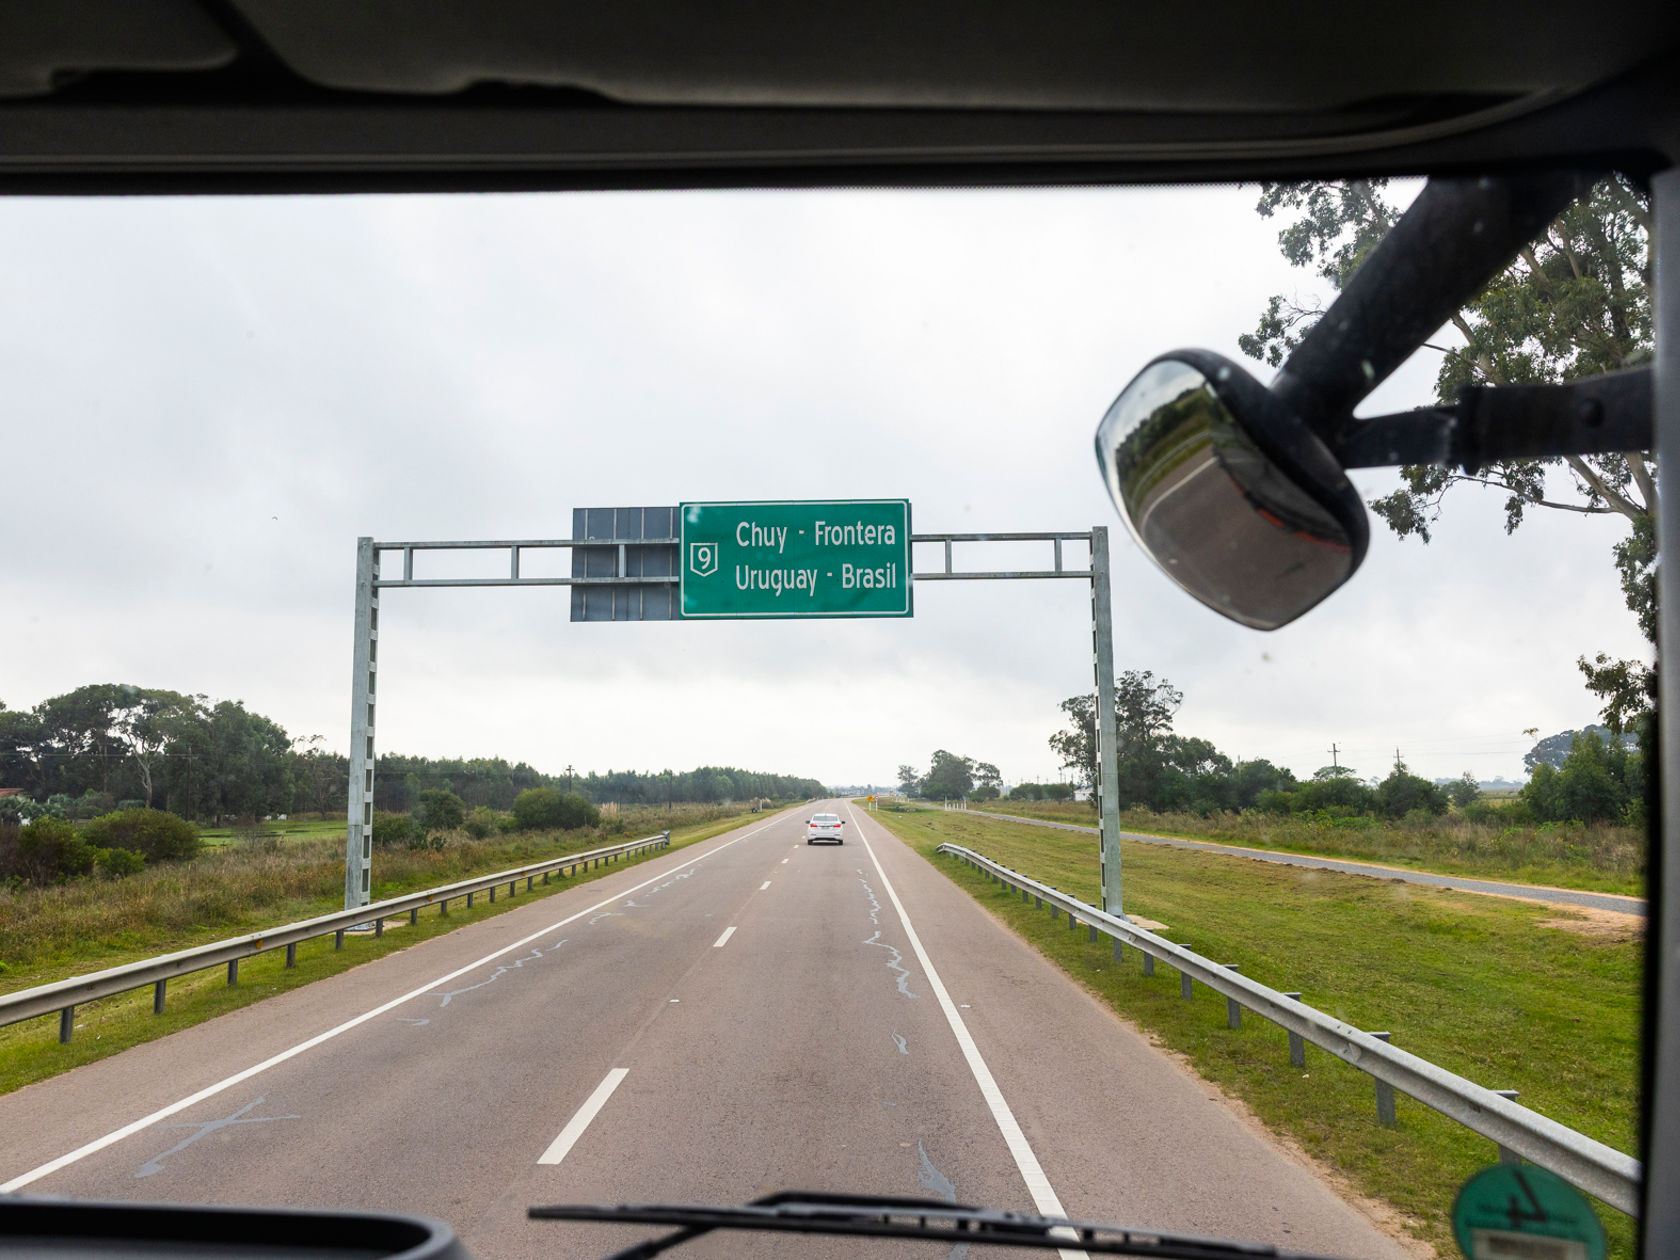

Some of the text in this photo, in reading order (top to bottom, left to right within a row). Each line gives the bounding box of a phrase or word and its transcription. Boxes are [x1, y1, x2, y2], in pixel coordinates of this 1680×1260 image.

[736, 521, 787, 554] Chuy
[815, 520, 895, 546] Frontera
[698, 547, 711, 570] 9
[736, 564, 818, 597] Uruguay
[842, 563, 896, 589] Brasil
